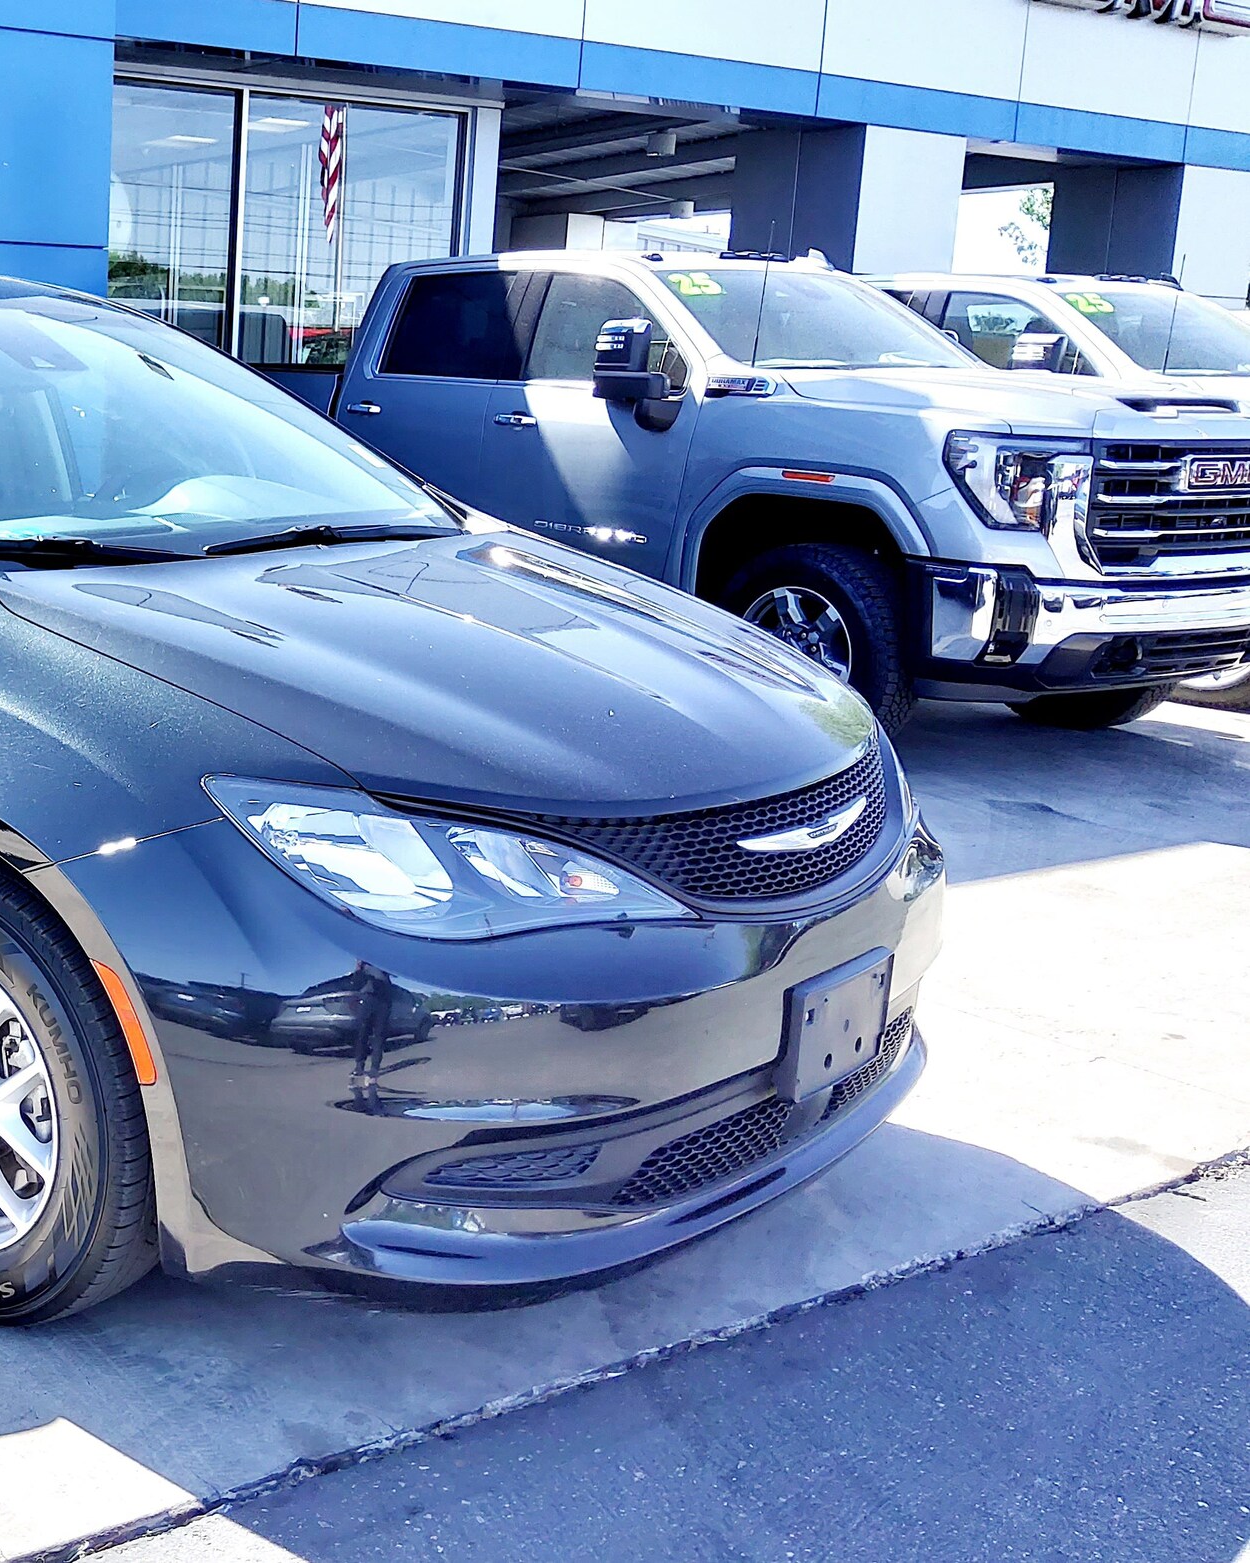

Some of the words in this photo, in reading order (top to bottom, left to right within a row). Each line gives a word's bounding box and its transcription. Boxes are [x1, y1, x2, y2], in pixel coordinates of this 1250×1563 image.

[667, 271, 722, 296] 25
[1065, 291, 1115, 314] 25
[1190, 460, 1250, 486] GM
[26, 983, 82, 1105] KUMHO
